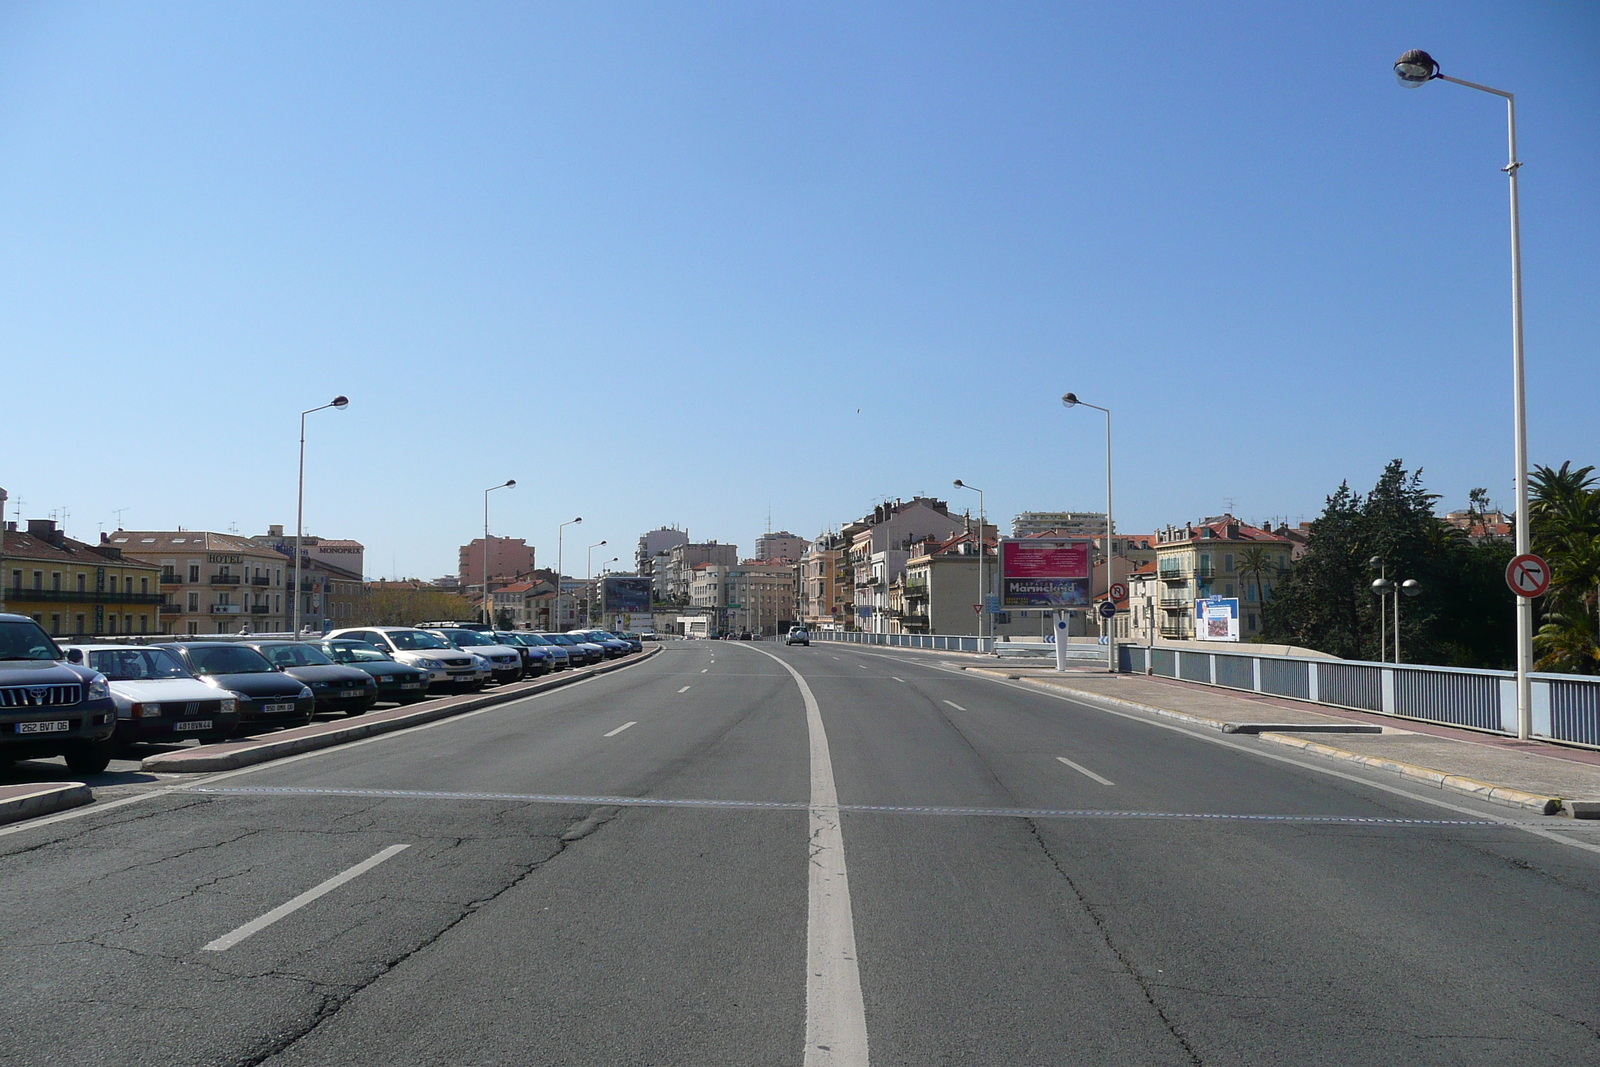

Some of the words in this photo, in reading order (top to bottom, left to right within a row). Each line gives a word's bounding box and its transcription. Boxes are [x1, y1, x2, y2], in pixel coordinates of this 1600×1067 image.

[208, 554, 244, 564] HOTEL
[22, 723, 37, 732] 262
[40, 722, 54, 731] BVT
[57, 721, 67, 730] 06
